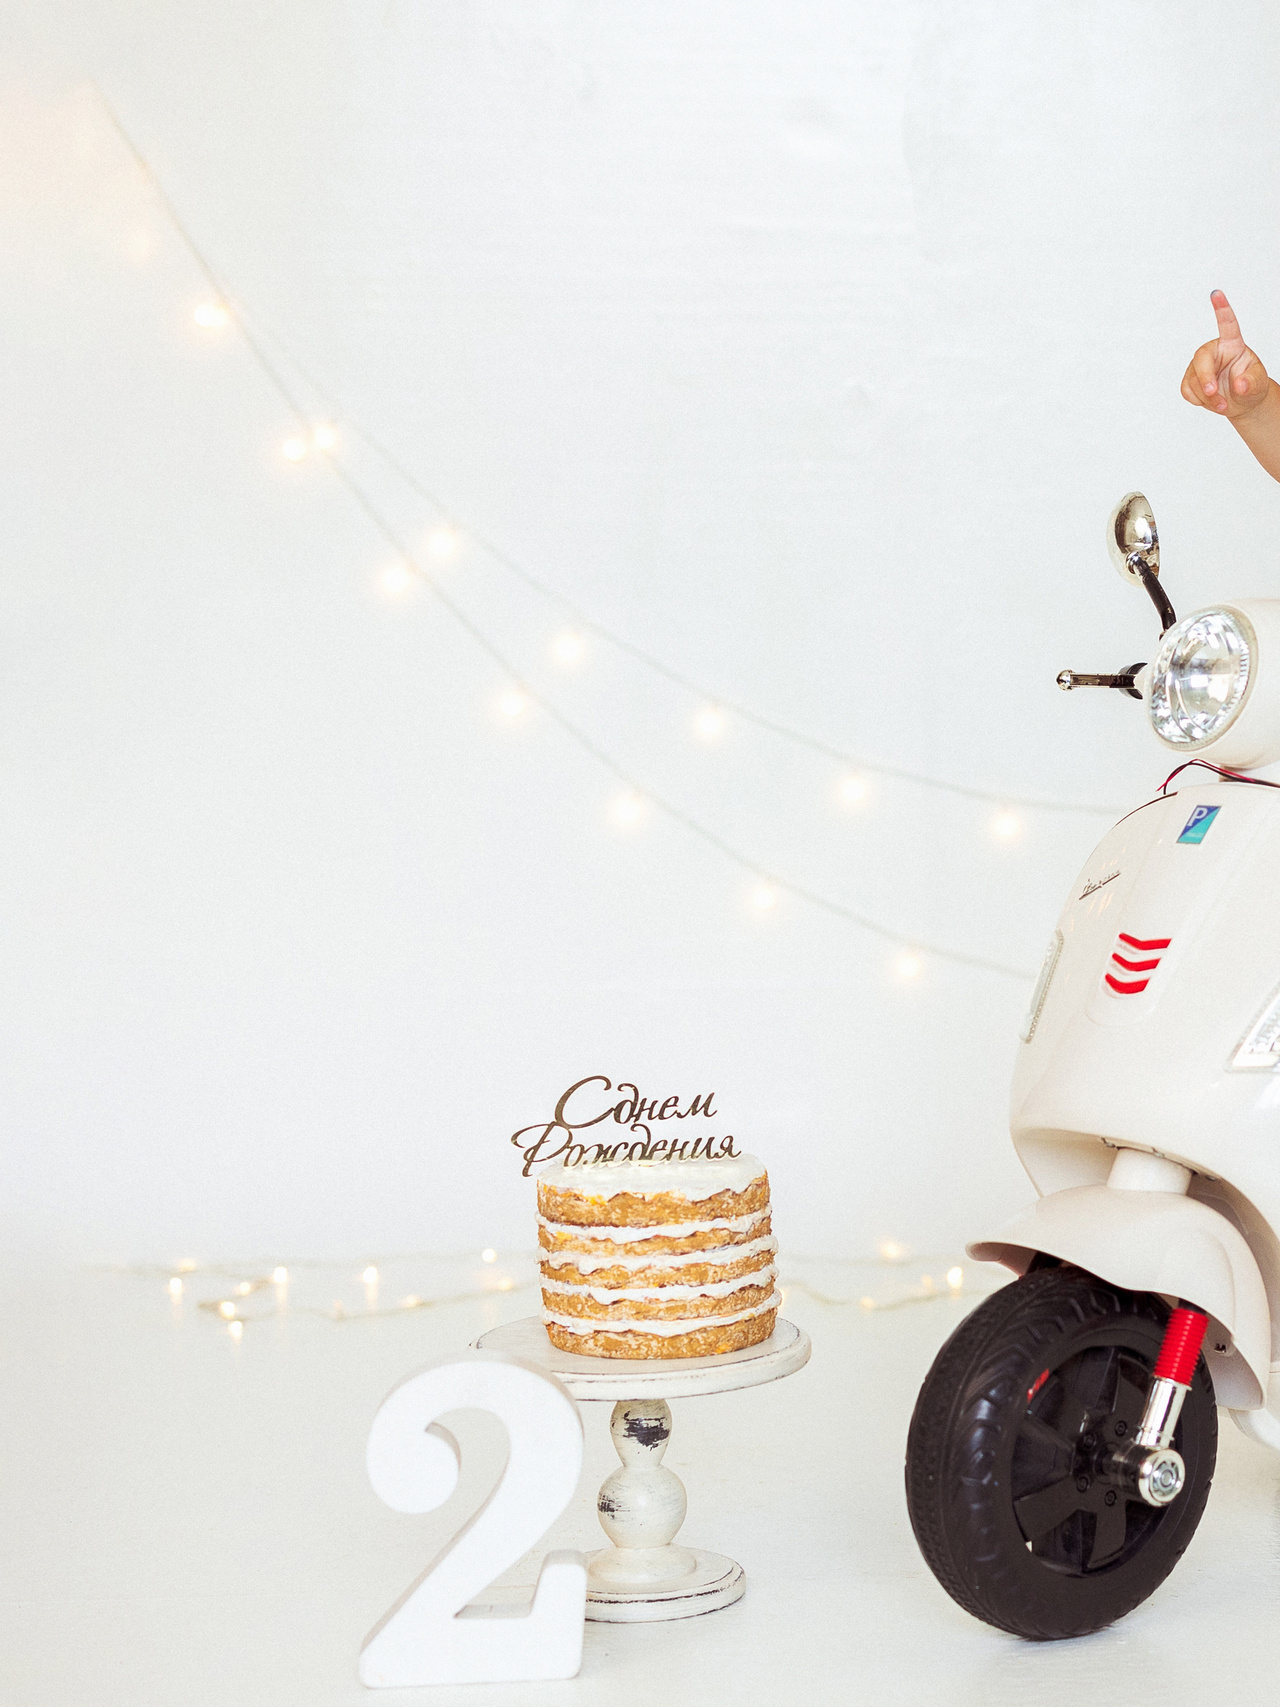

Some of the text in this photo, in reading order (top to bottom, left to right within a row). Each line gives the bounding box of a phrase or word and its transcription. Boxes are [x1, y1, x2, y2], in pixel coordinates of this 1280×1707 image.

[1187, 807, 1208, 827] P
[510, 1121, 742, 1178] Рождения
[358, 1356, 588, 1689] 2
